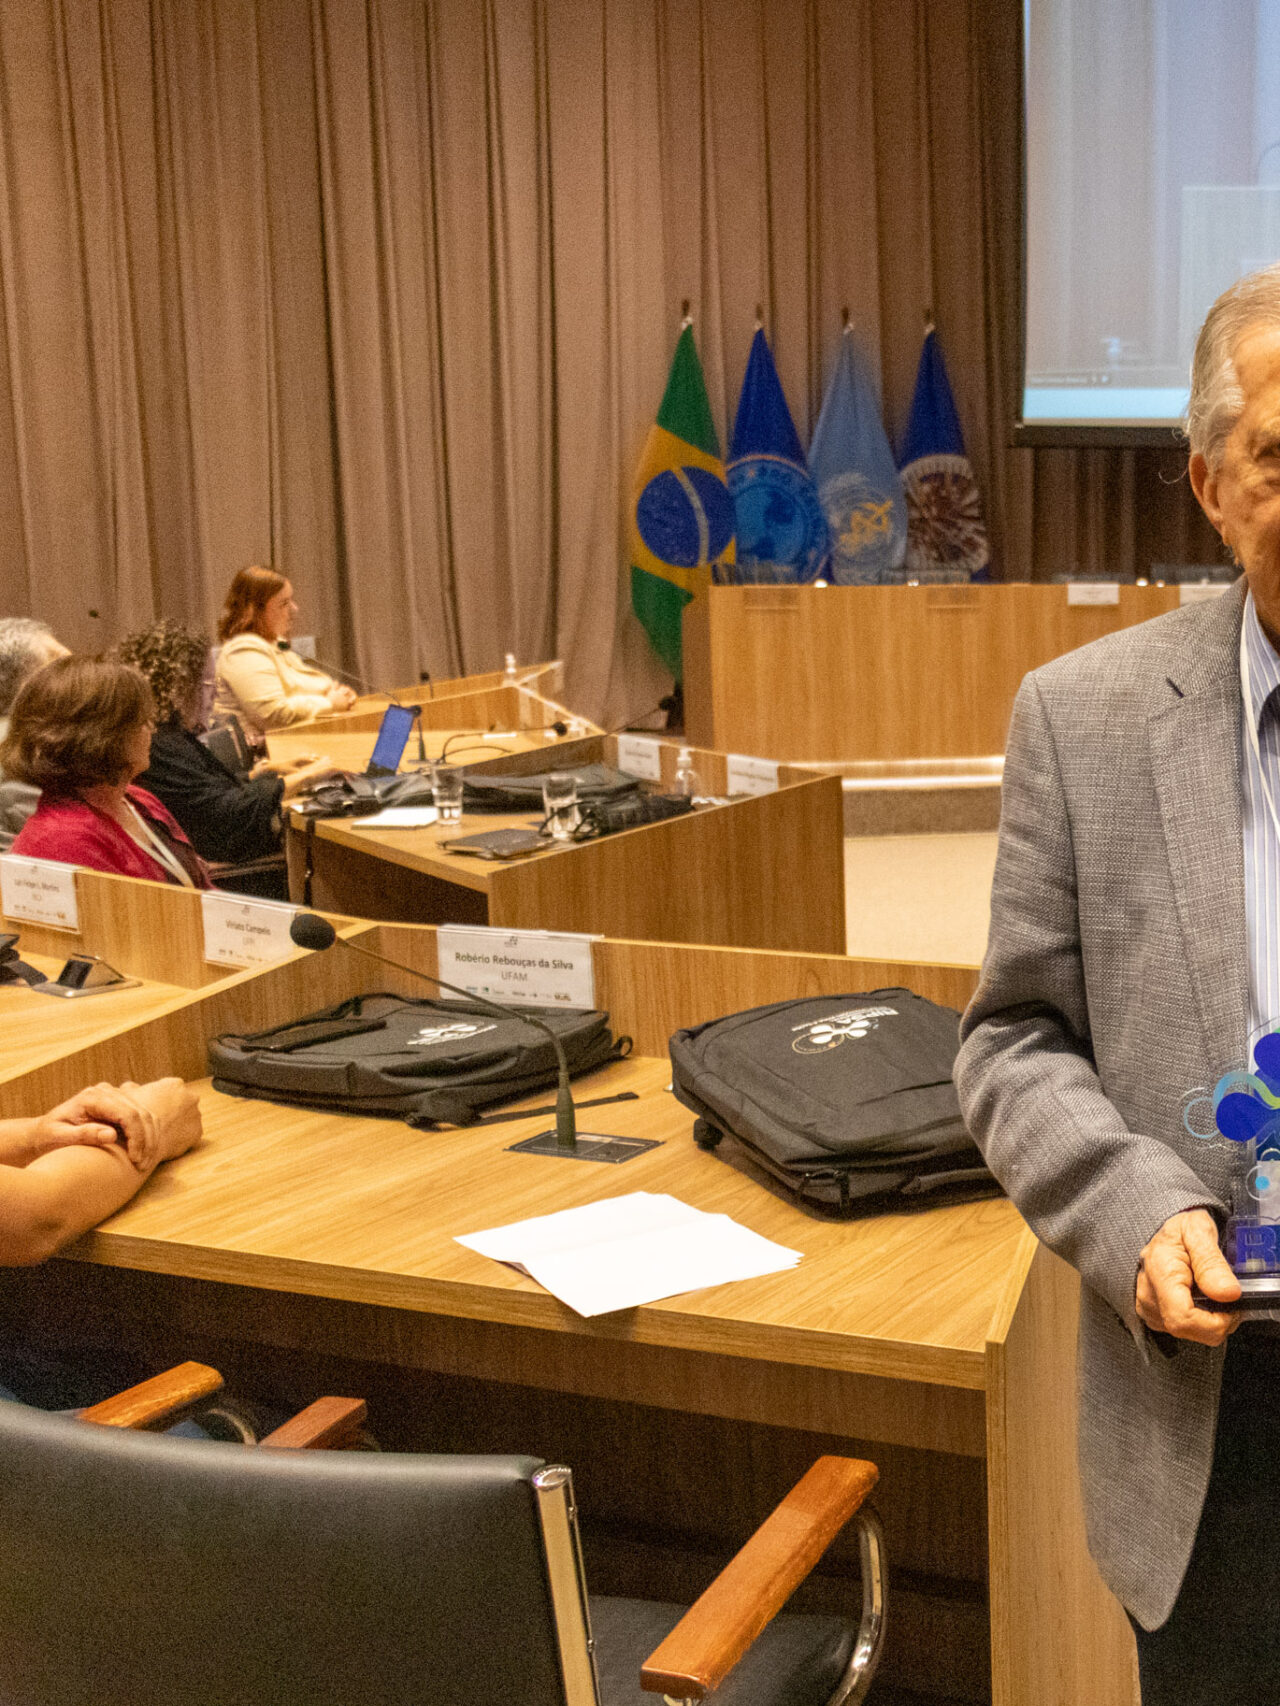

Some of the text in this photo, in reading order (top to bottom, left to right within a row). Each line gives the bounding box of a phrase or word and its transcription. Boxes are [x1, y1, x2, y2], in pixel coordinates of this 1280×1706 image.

[455, 952, 490, 964] Robério
[493, 955, 537, 968] Rebouças
[552, 960, 574, 970] Silva
[501, 971, 528, 981] UFAM
